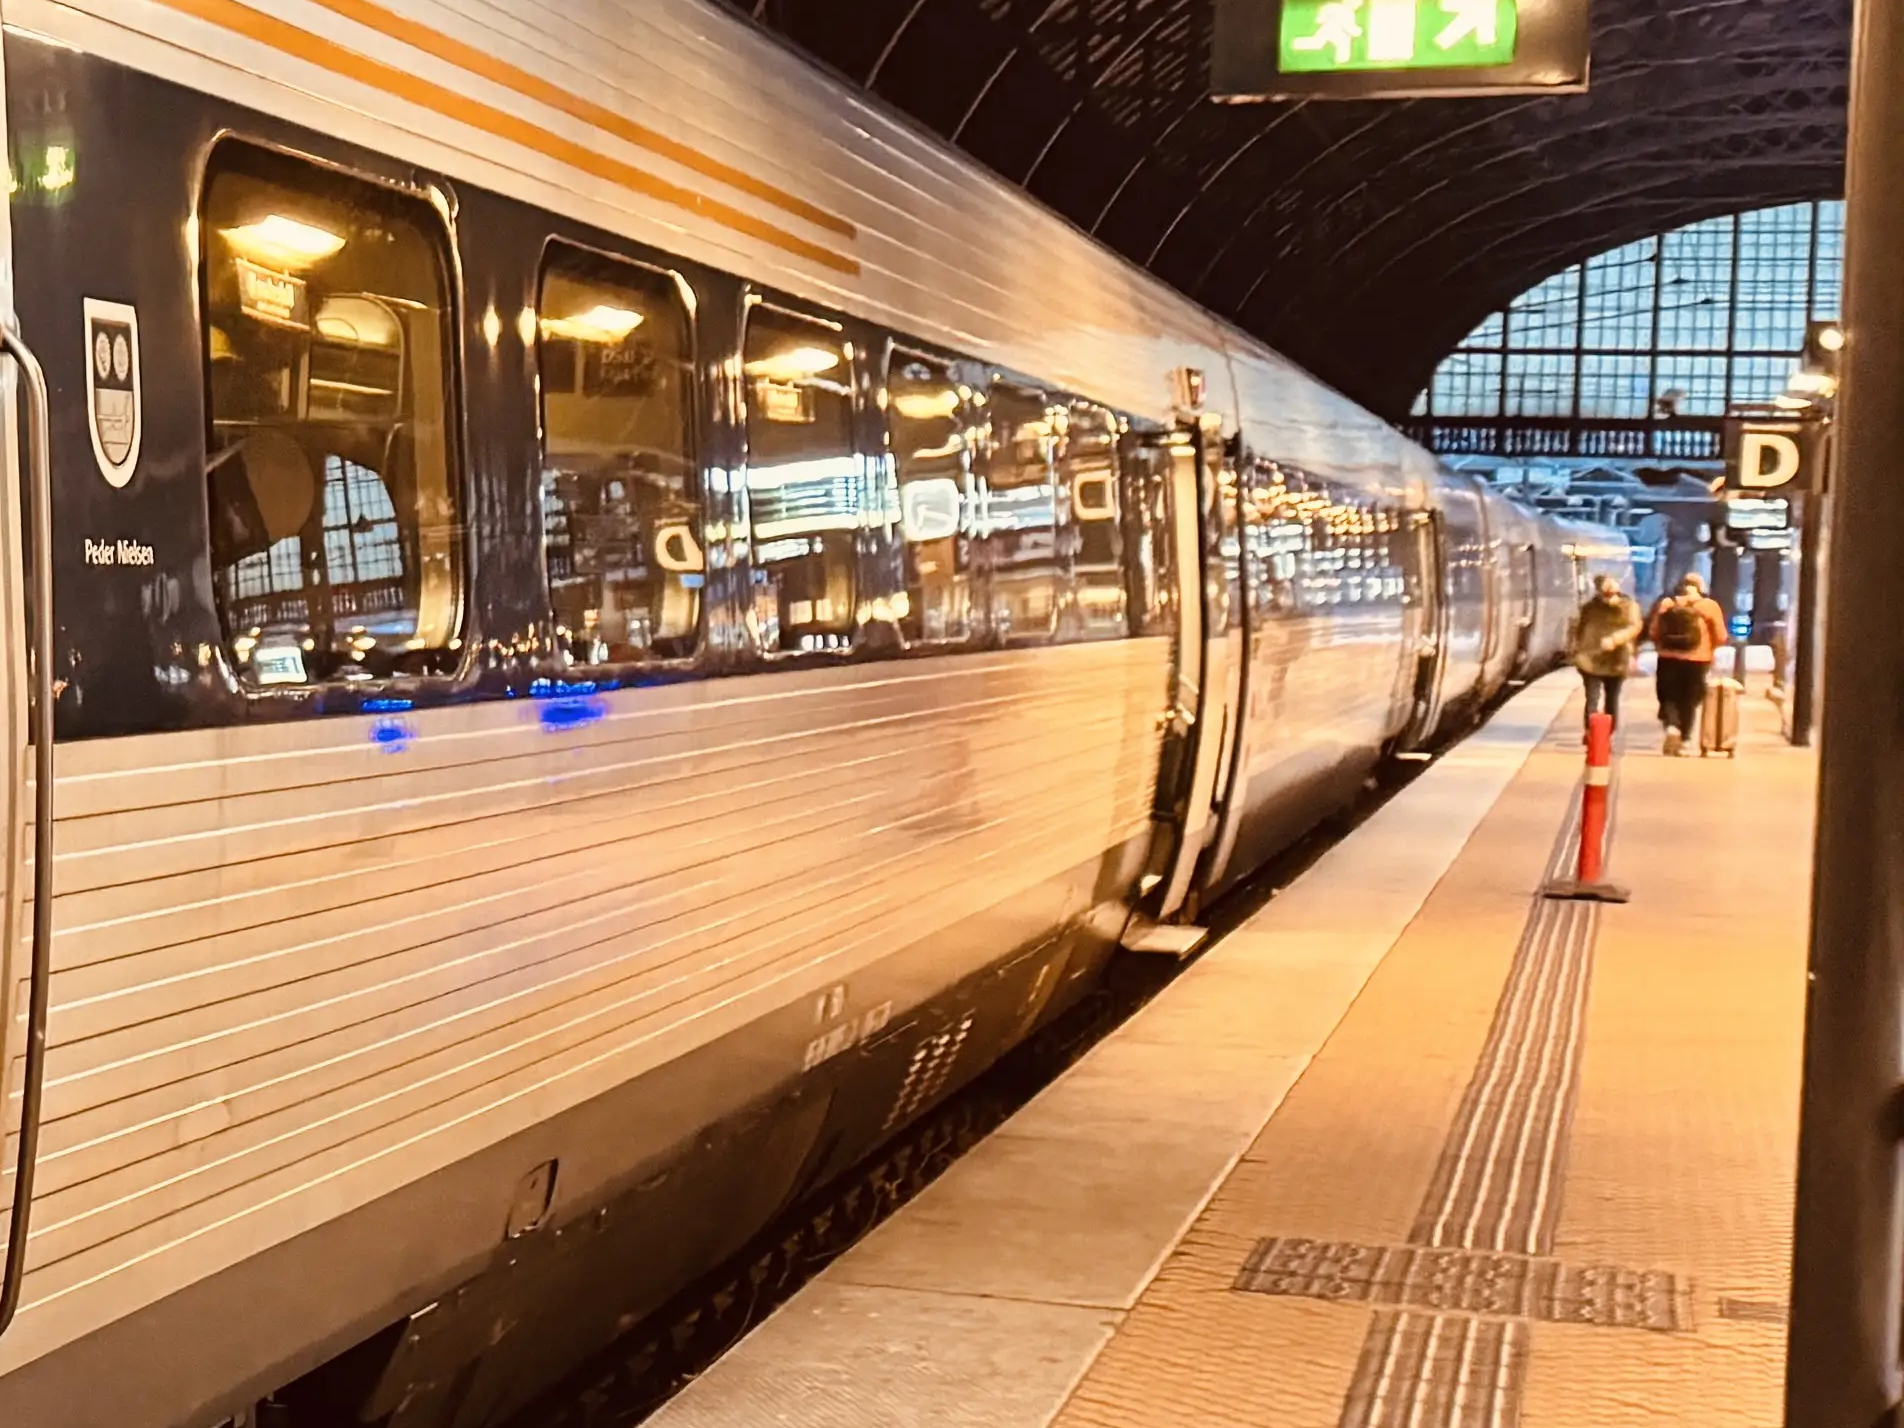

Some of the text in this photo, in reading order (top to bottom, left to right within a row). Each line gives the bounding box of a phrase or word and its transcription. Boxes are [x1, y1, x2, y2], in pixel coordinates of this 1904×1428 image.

[1740, 433, 1800, 487] D
[84, 538, 154, 566] Peder Nielsen
